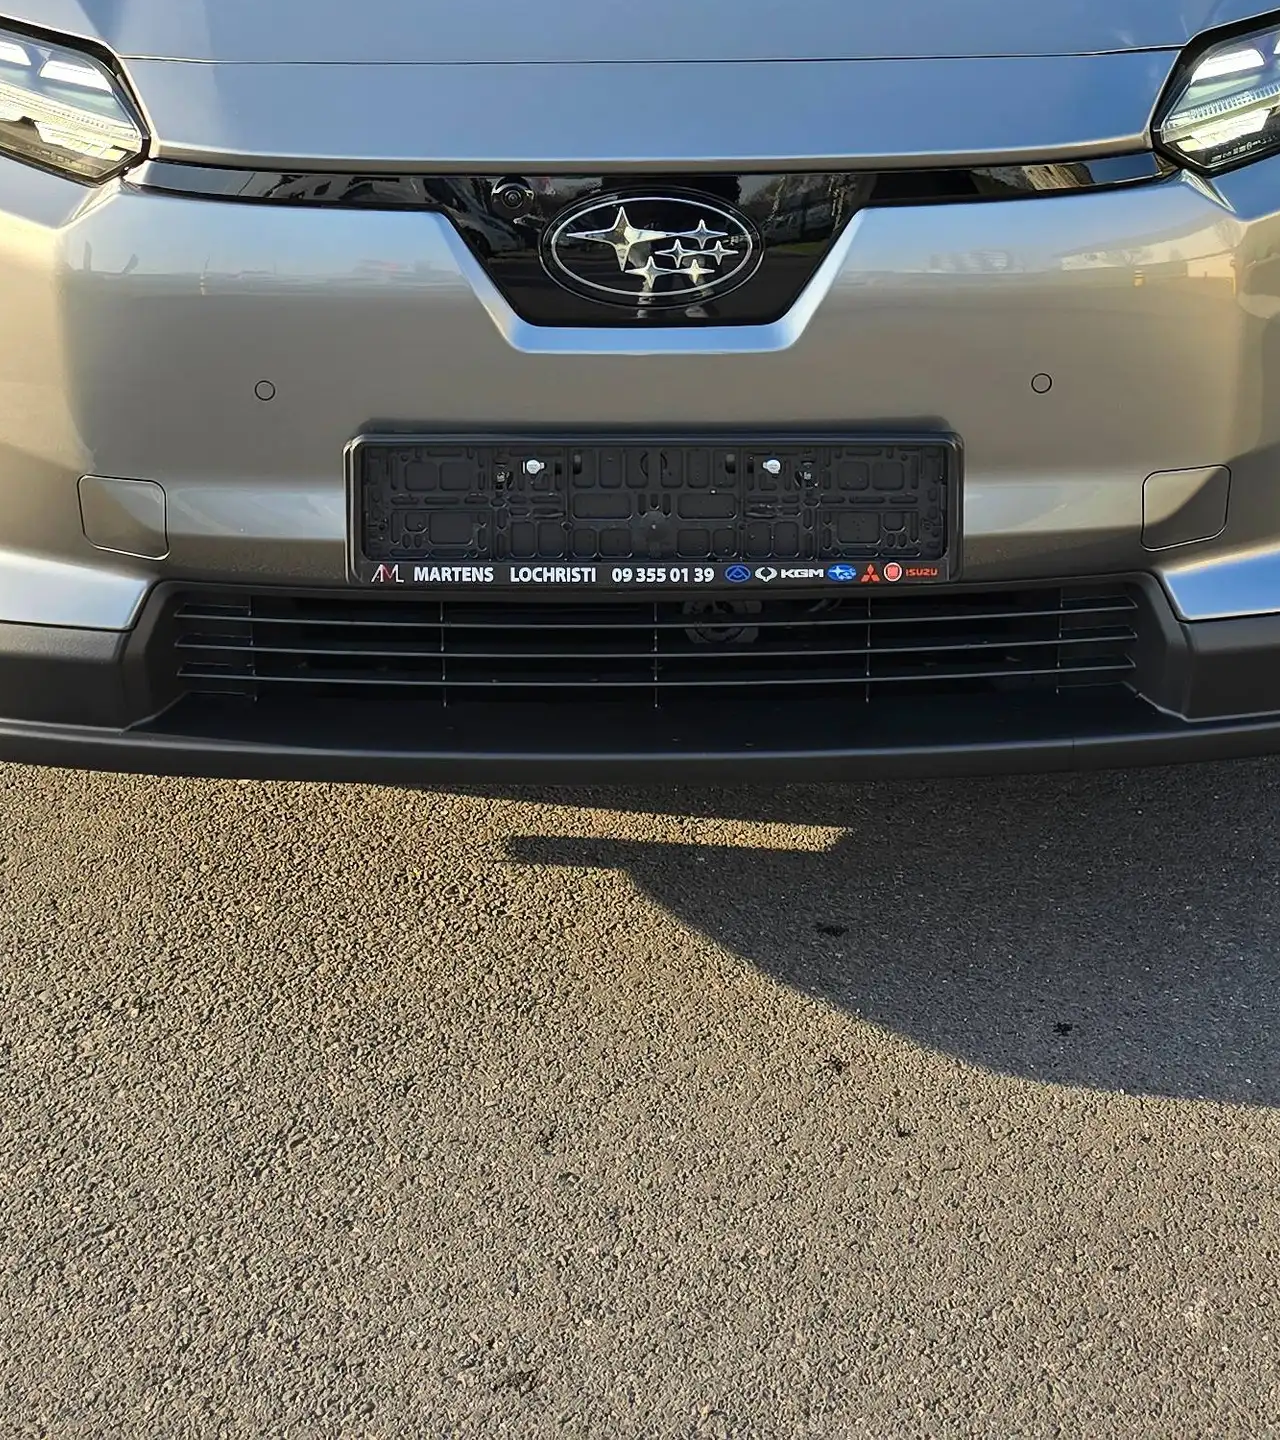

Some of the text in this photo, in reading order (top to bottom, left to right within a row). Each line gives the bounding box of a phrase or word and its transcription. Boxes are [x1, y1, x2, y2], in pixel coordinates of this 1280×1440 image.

[413, 566, 494, 583] MARTENS
[510, 566, 597, 583] LOCHRISTI
[611, 567, 633, 583] 09
[635, 567, 667, 583] 355
[669, 567, 689, 583] 01
[693, 567, 715, 583] 39
[780, 568, 825, 579] KGM
[905, 568, 938, 577] ISUZU
